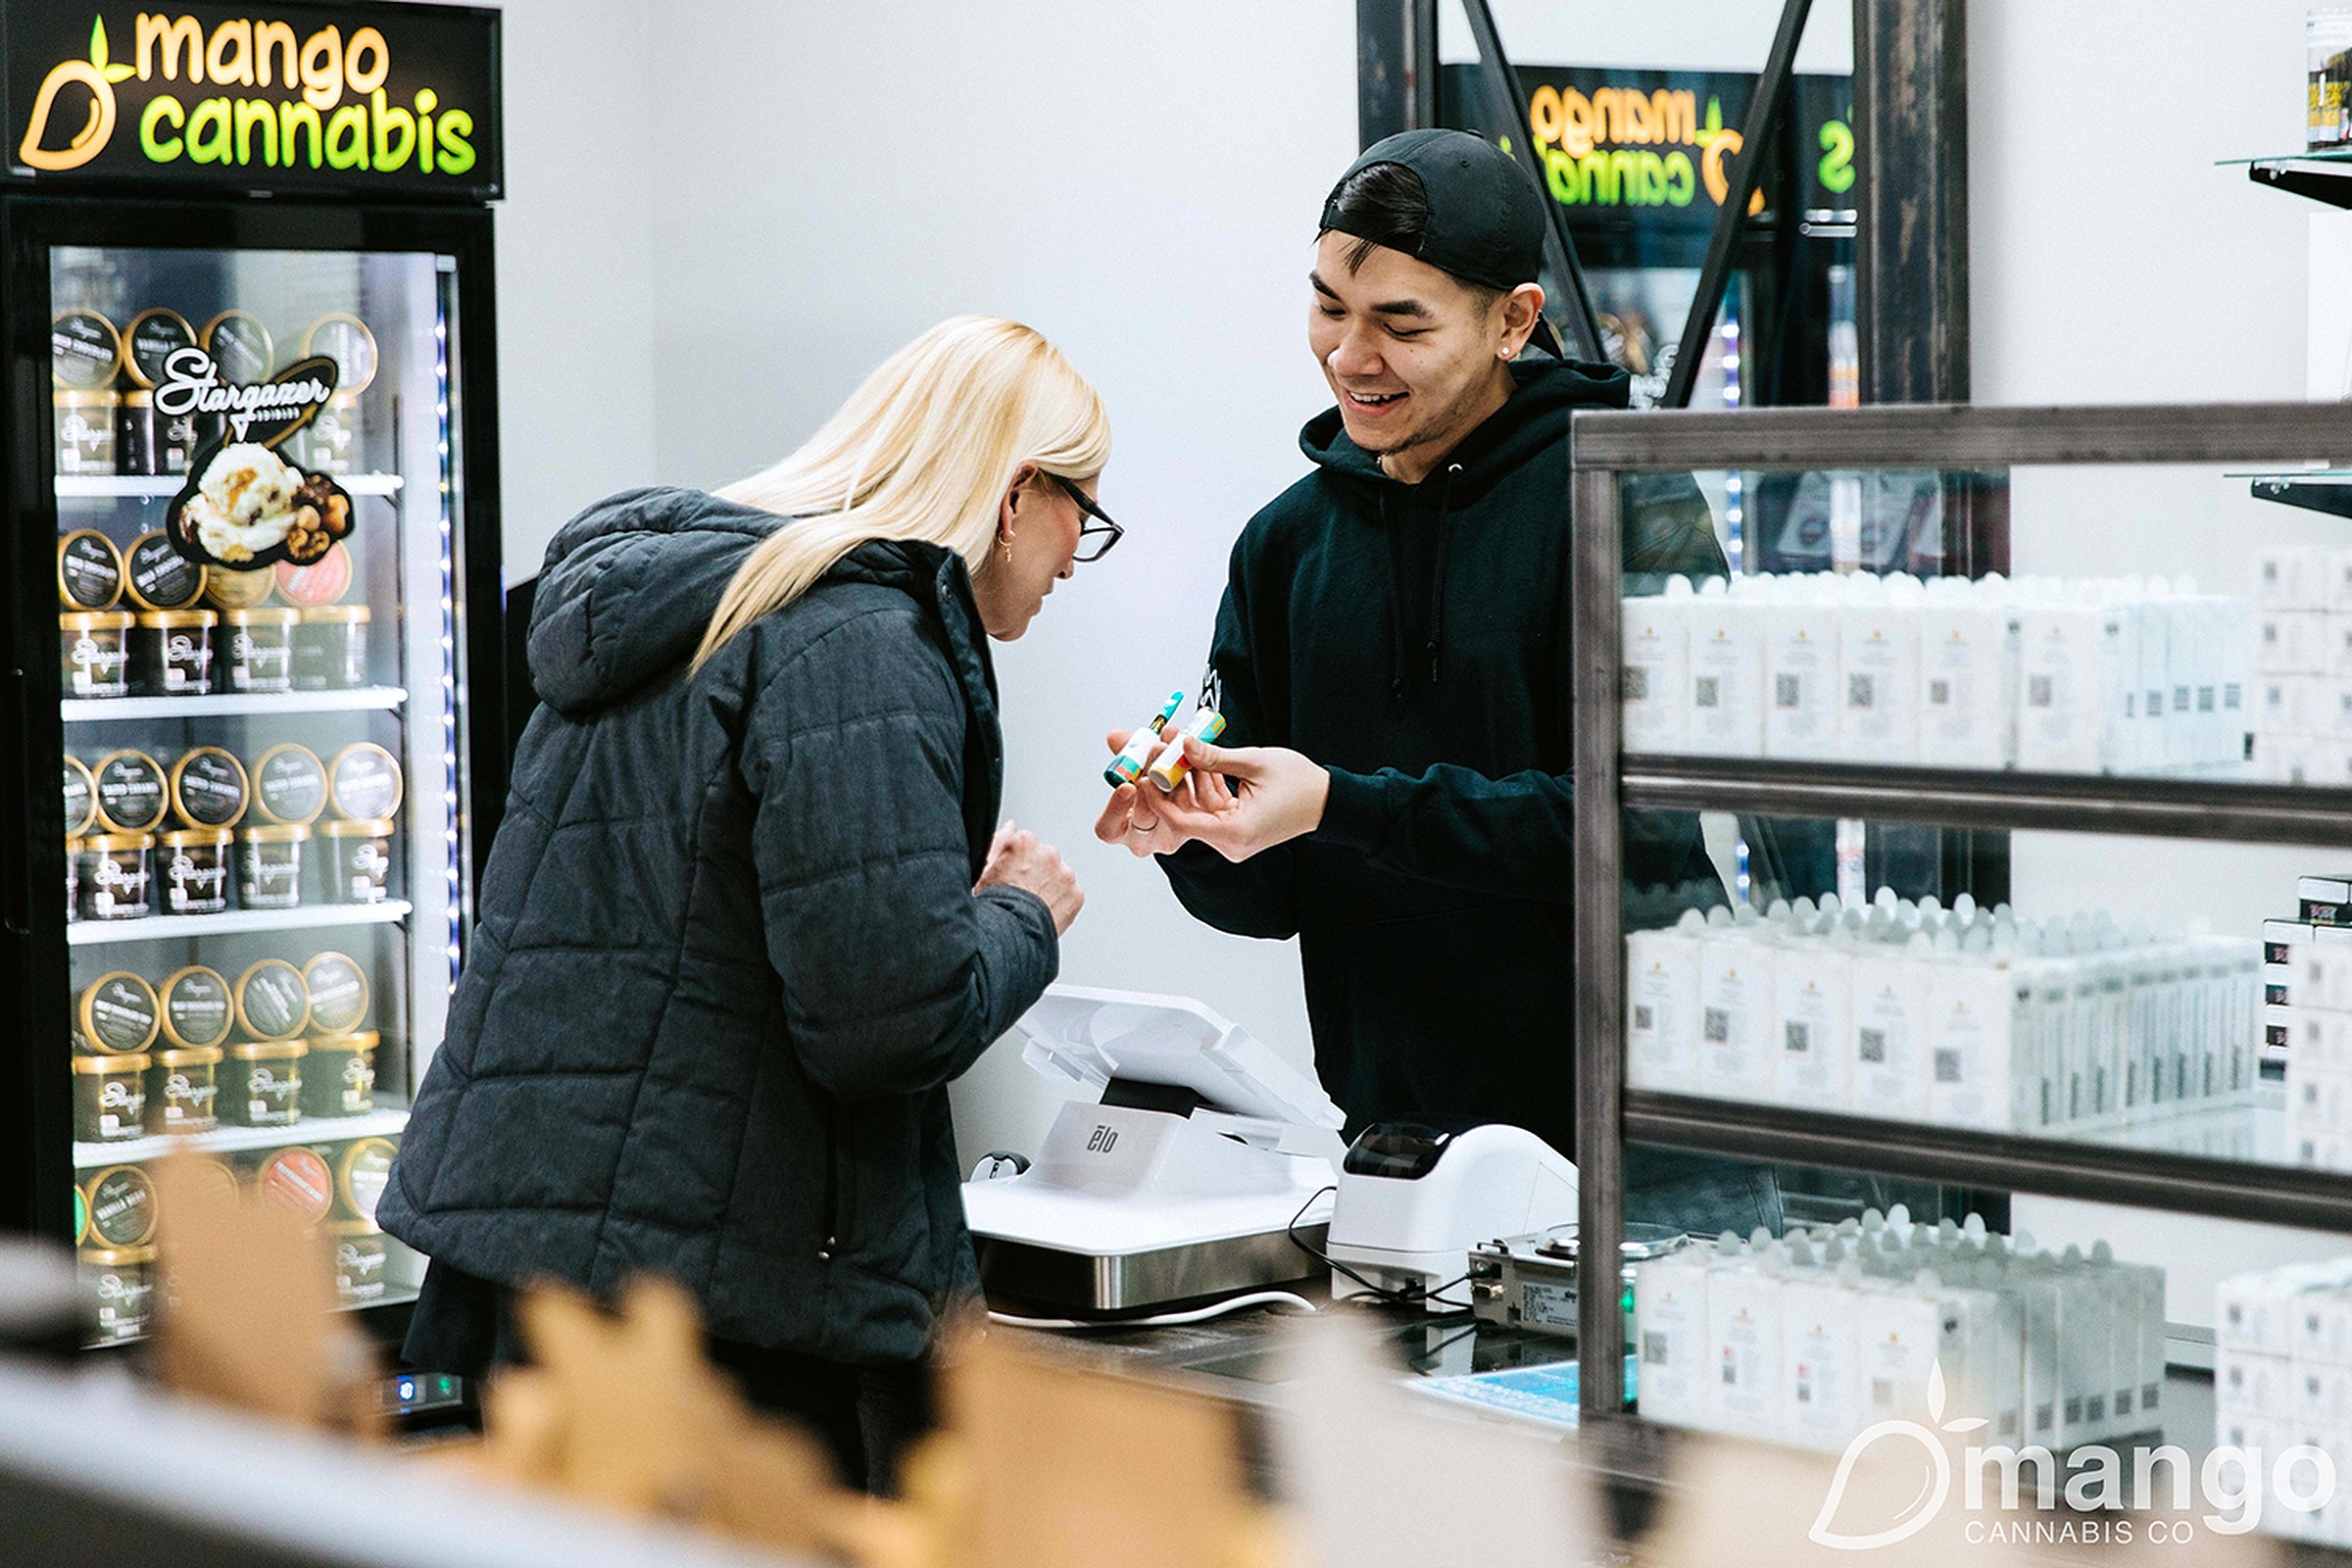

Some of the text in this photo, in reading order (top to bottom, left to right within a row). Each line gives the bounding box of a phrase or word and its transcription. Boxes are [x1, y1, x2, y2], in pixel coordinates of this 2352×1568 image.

[135, 12, 390, 111] mango
[139, 87, 477, 174] cannabis
[155, 347, 331, 441] Stargazer
